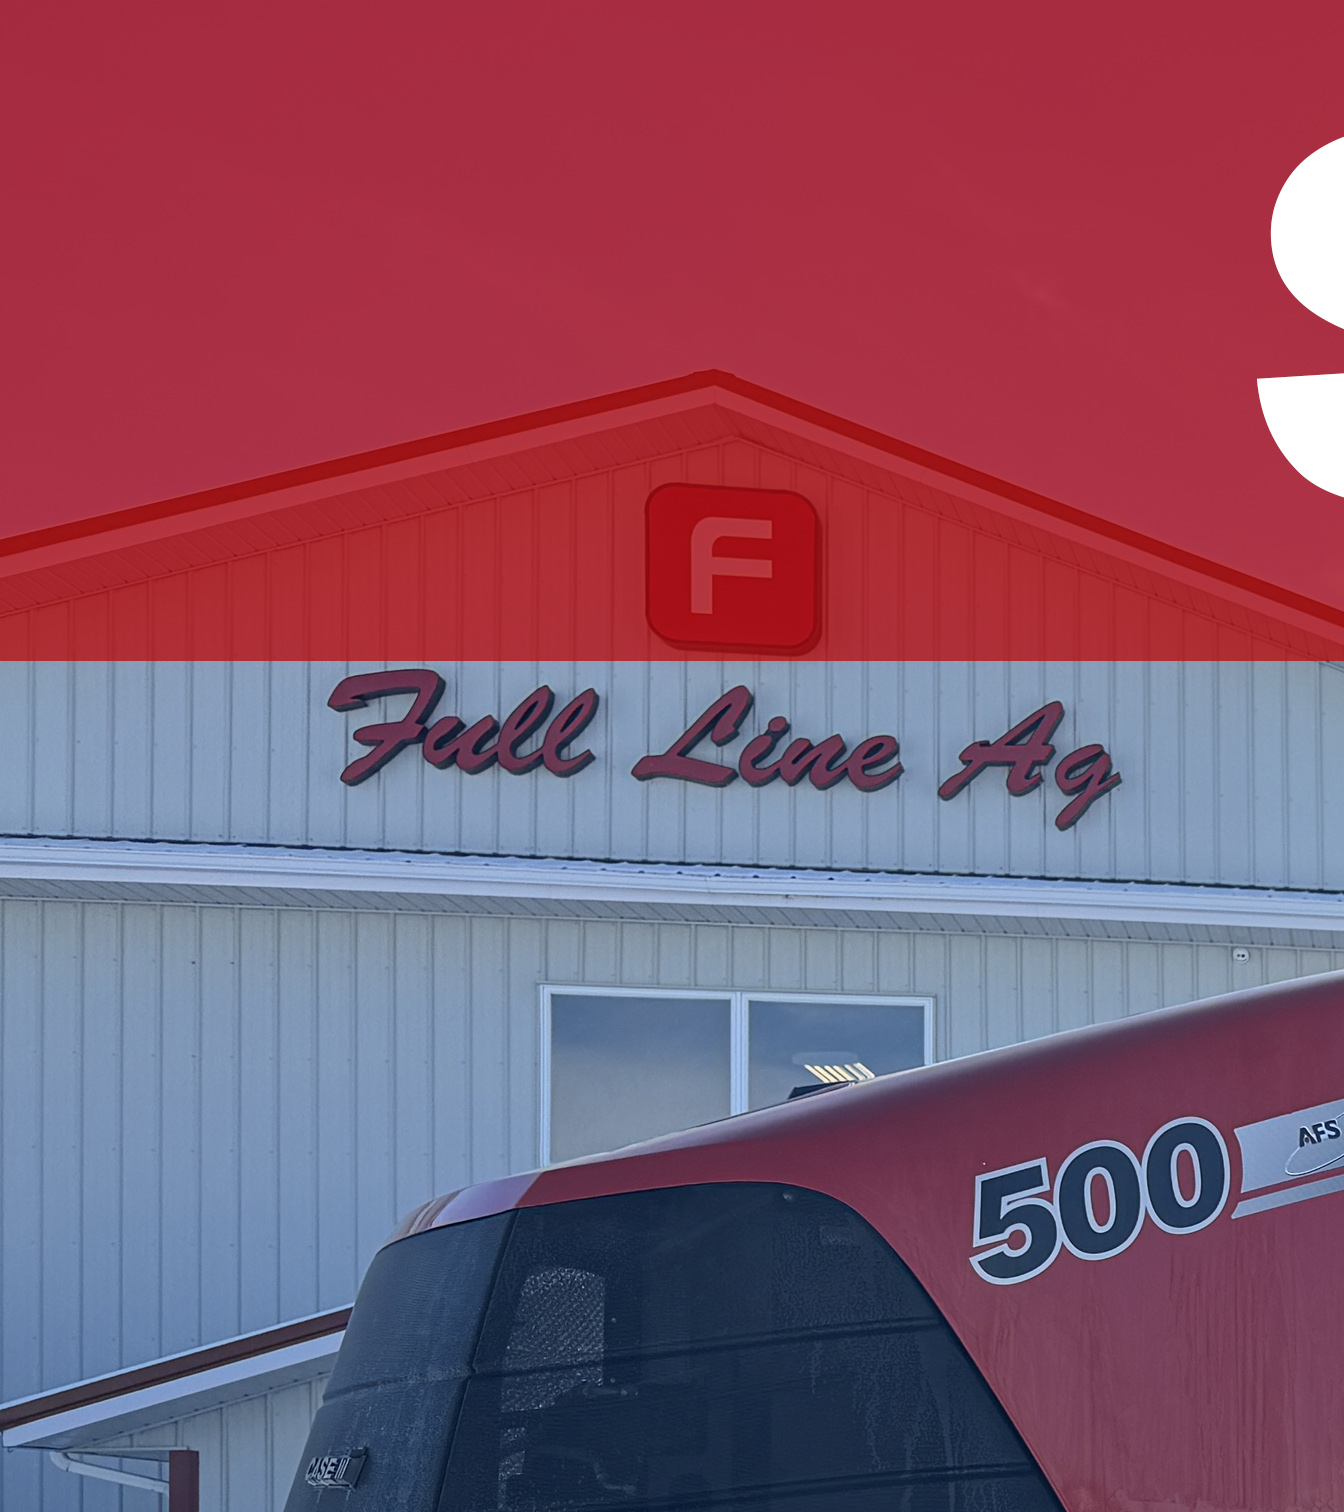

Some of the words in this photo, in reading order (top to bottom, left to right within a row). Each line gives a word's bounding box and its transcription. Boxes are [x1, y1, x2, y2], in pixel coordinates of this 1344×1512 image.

[690, 516, 773, 615] F
[327, 668, 600, 787] Full
[631, 685, 904, 792] Line
[937, 700, 1122, 831] Ag
[1298, 1119, 1342, 1148] AFS
[969, 1116, 1230, 1285] 500
